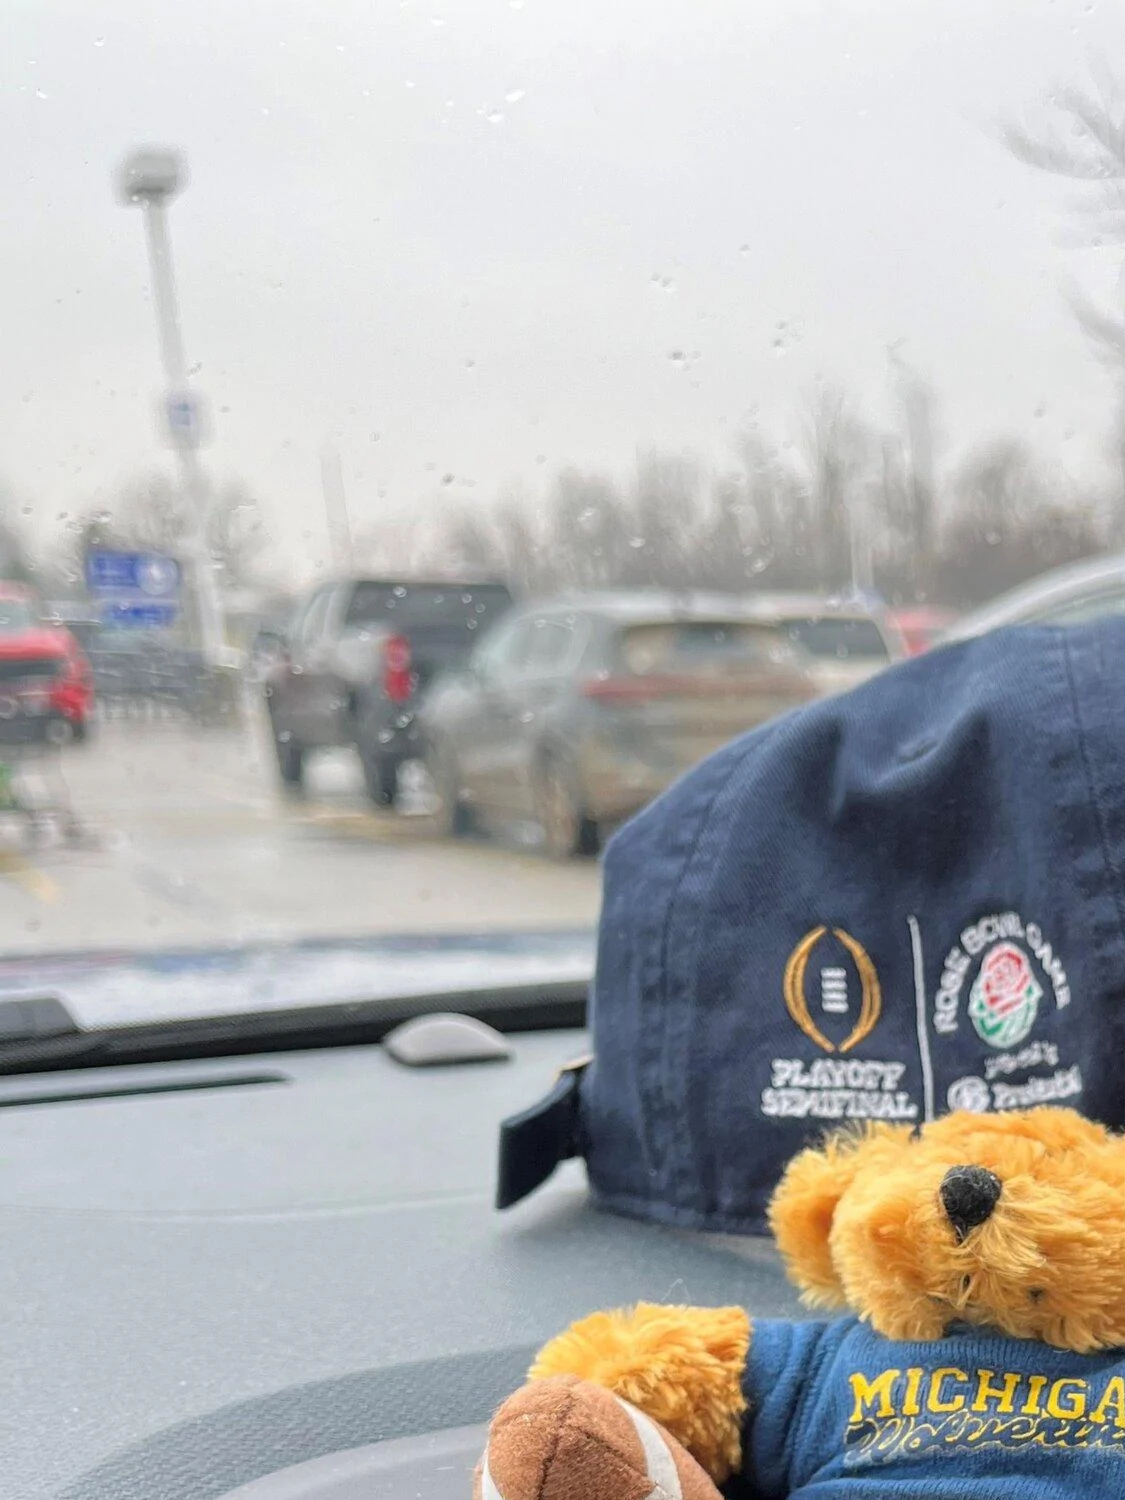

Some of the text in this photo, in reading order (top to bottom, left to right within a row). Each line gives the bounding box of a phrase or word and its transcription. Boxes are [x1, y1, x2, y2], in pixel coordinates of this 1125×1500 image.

[933, 946, 971, 1034] ROSE
[960, 911, 1026, 955] BOWL
[772, 1058, 906, 1091] PLAYOFF
[761, 1086, 919, 1118] SEMIFINAL
